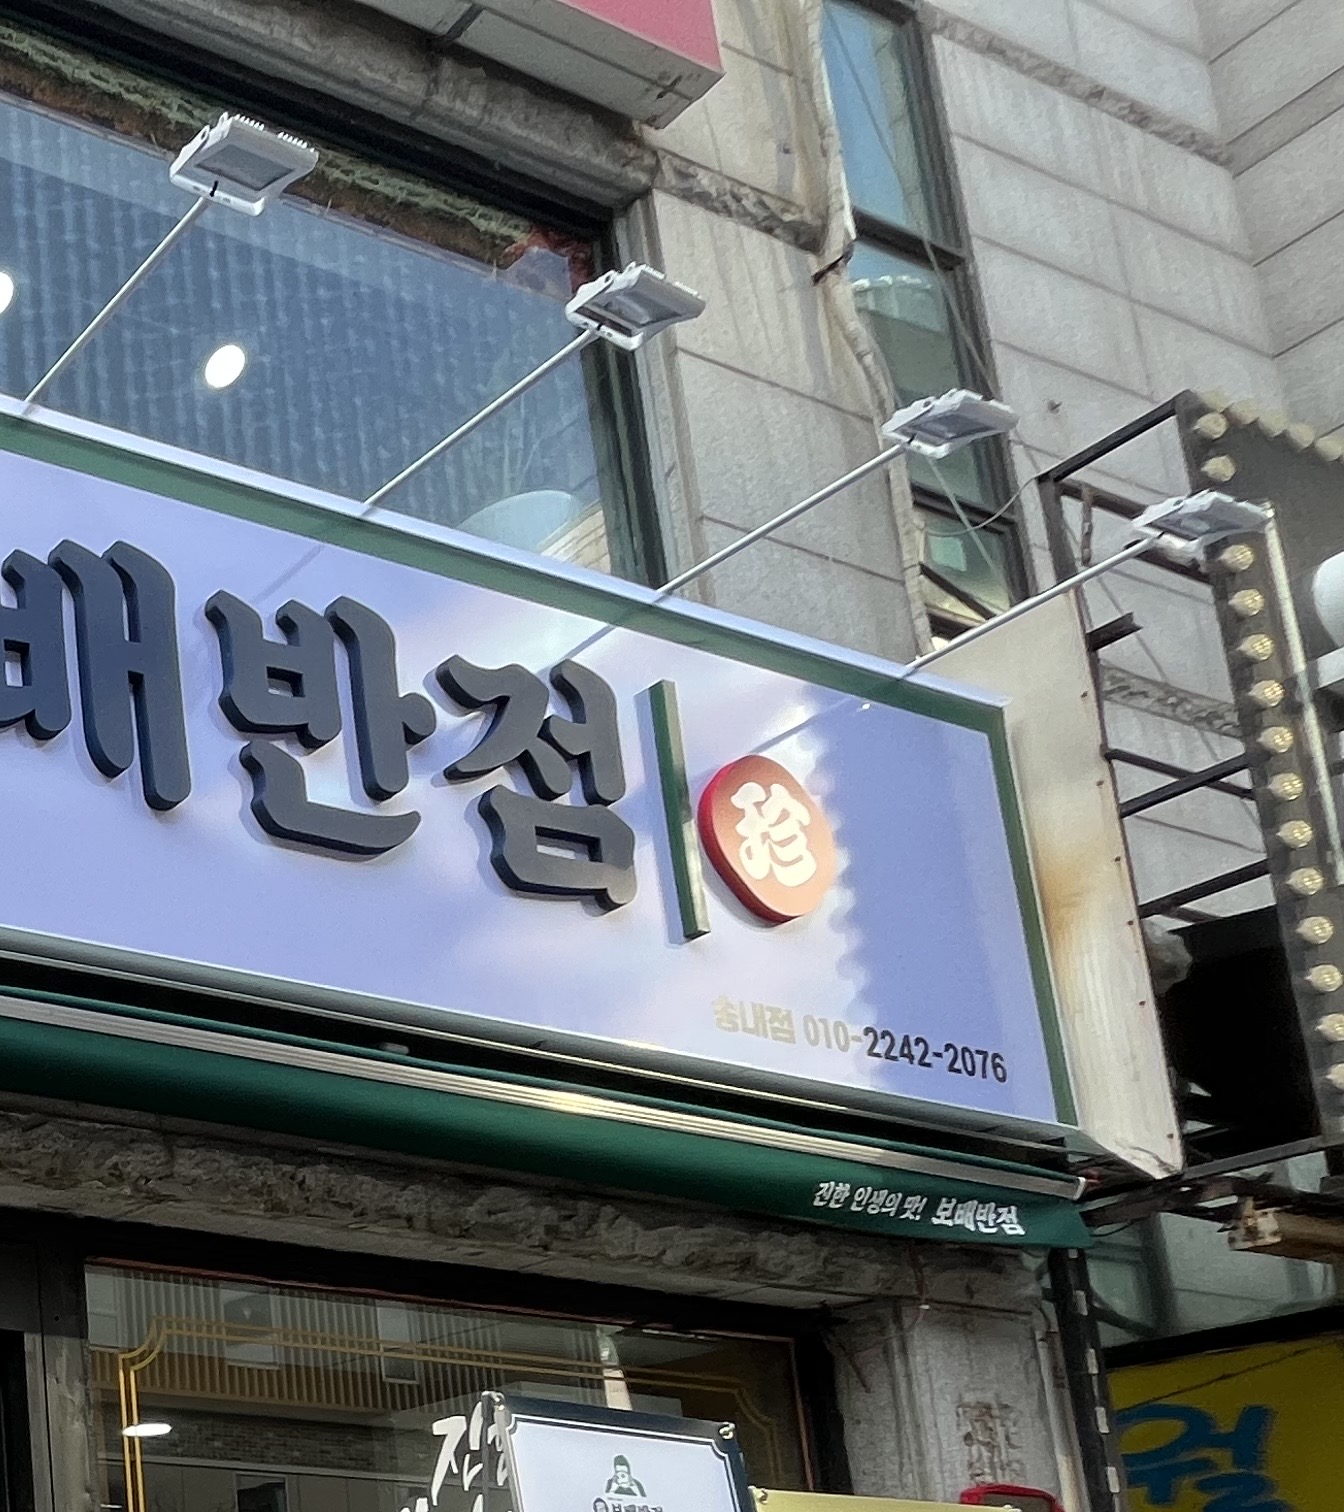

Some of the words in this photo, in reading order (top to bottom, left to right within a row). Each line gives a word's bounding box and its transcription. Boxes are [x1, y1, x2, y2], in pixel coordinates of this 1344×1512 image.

[712, 996, 796, 1045] 송내점
[803, 1016, 1008, 1083] 010-2242-2076
[813, 1181, 851, 1208] 진한
[850, 1186, 902, 1216] 인생의
[931, 1197, 1026, 1235] 보배반점
